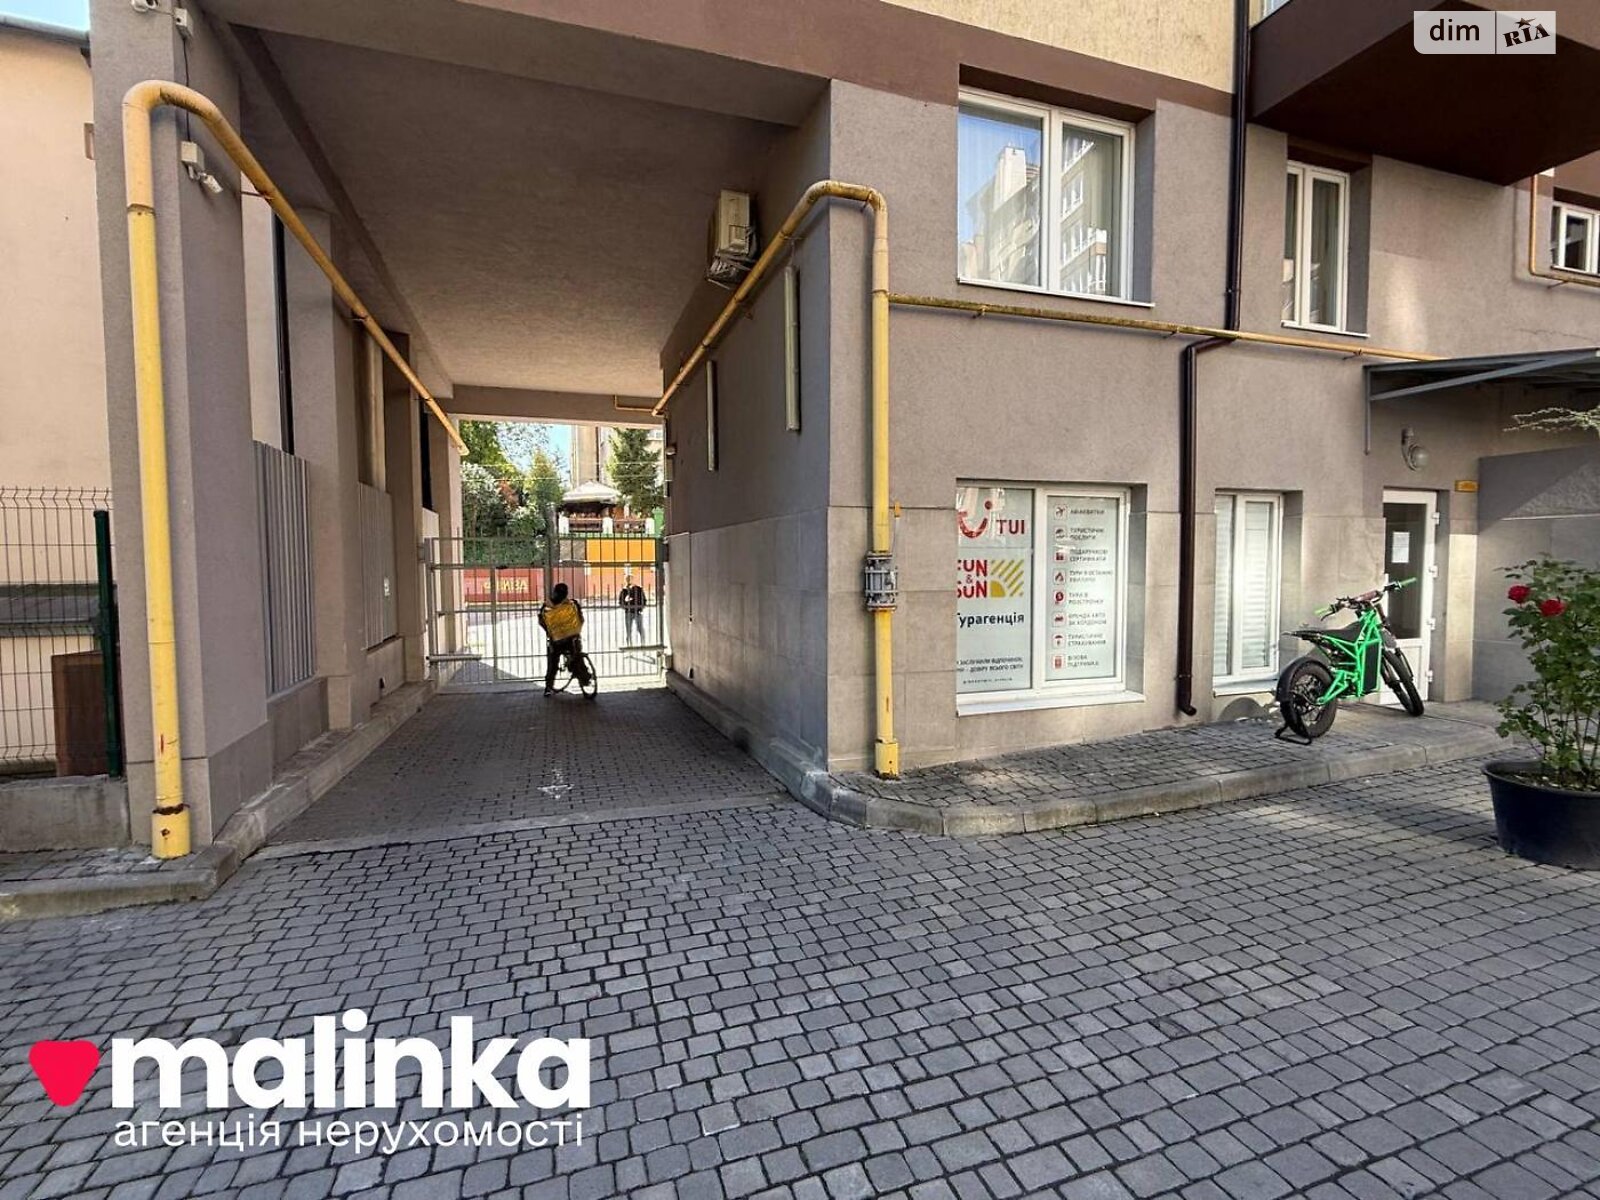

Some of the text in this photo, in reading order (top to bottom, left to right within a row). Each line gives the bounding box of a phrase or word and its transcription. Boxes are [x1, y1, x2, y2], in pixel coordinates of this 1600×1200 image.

[996, 519, 1025, 535] TUI
[957, 559, 987, 577] UN
[965, 574, 973, 584] &
[957, 612, 1024, 628] урагенція
